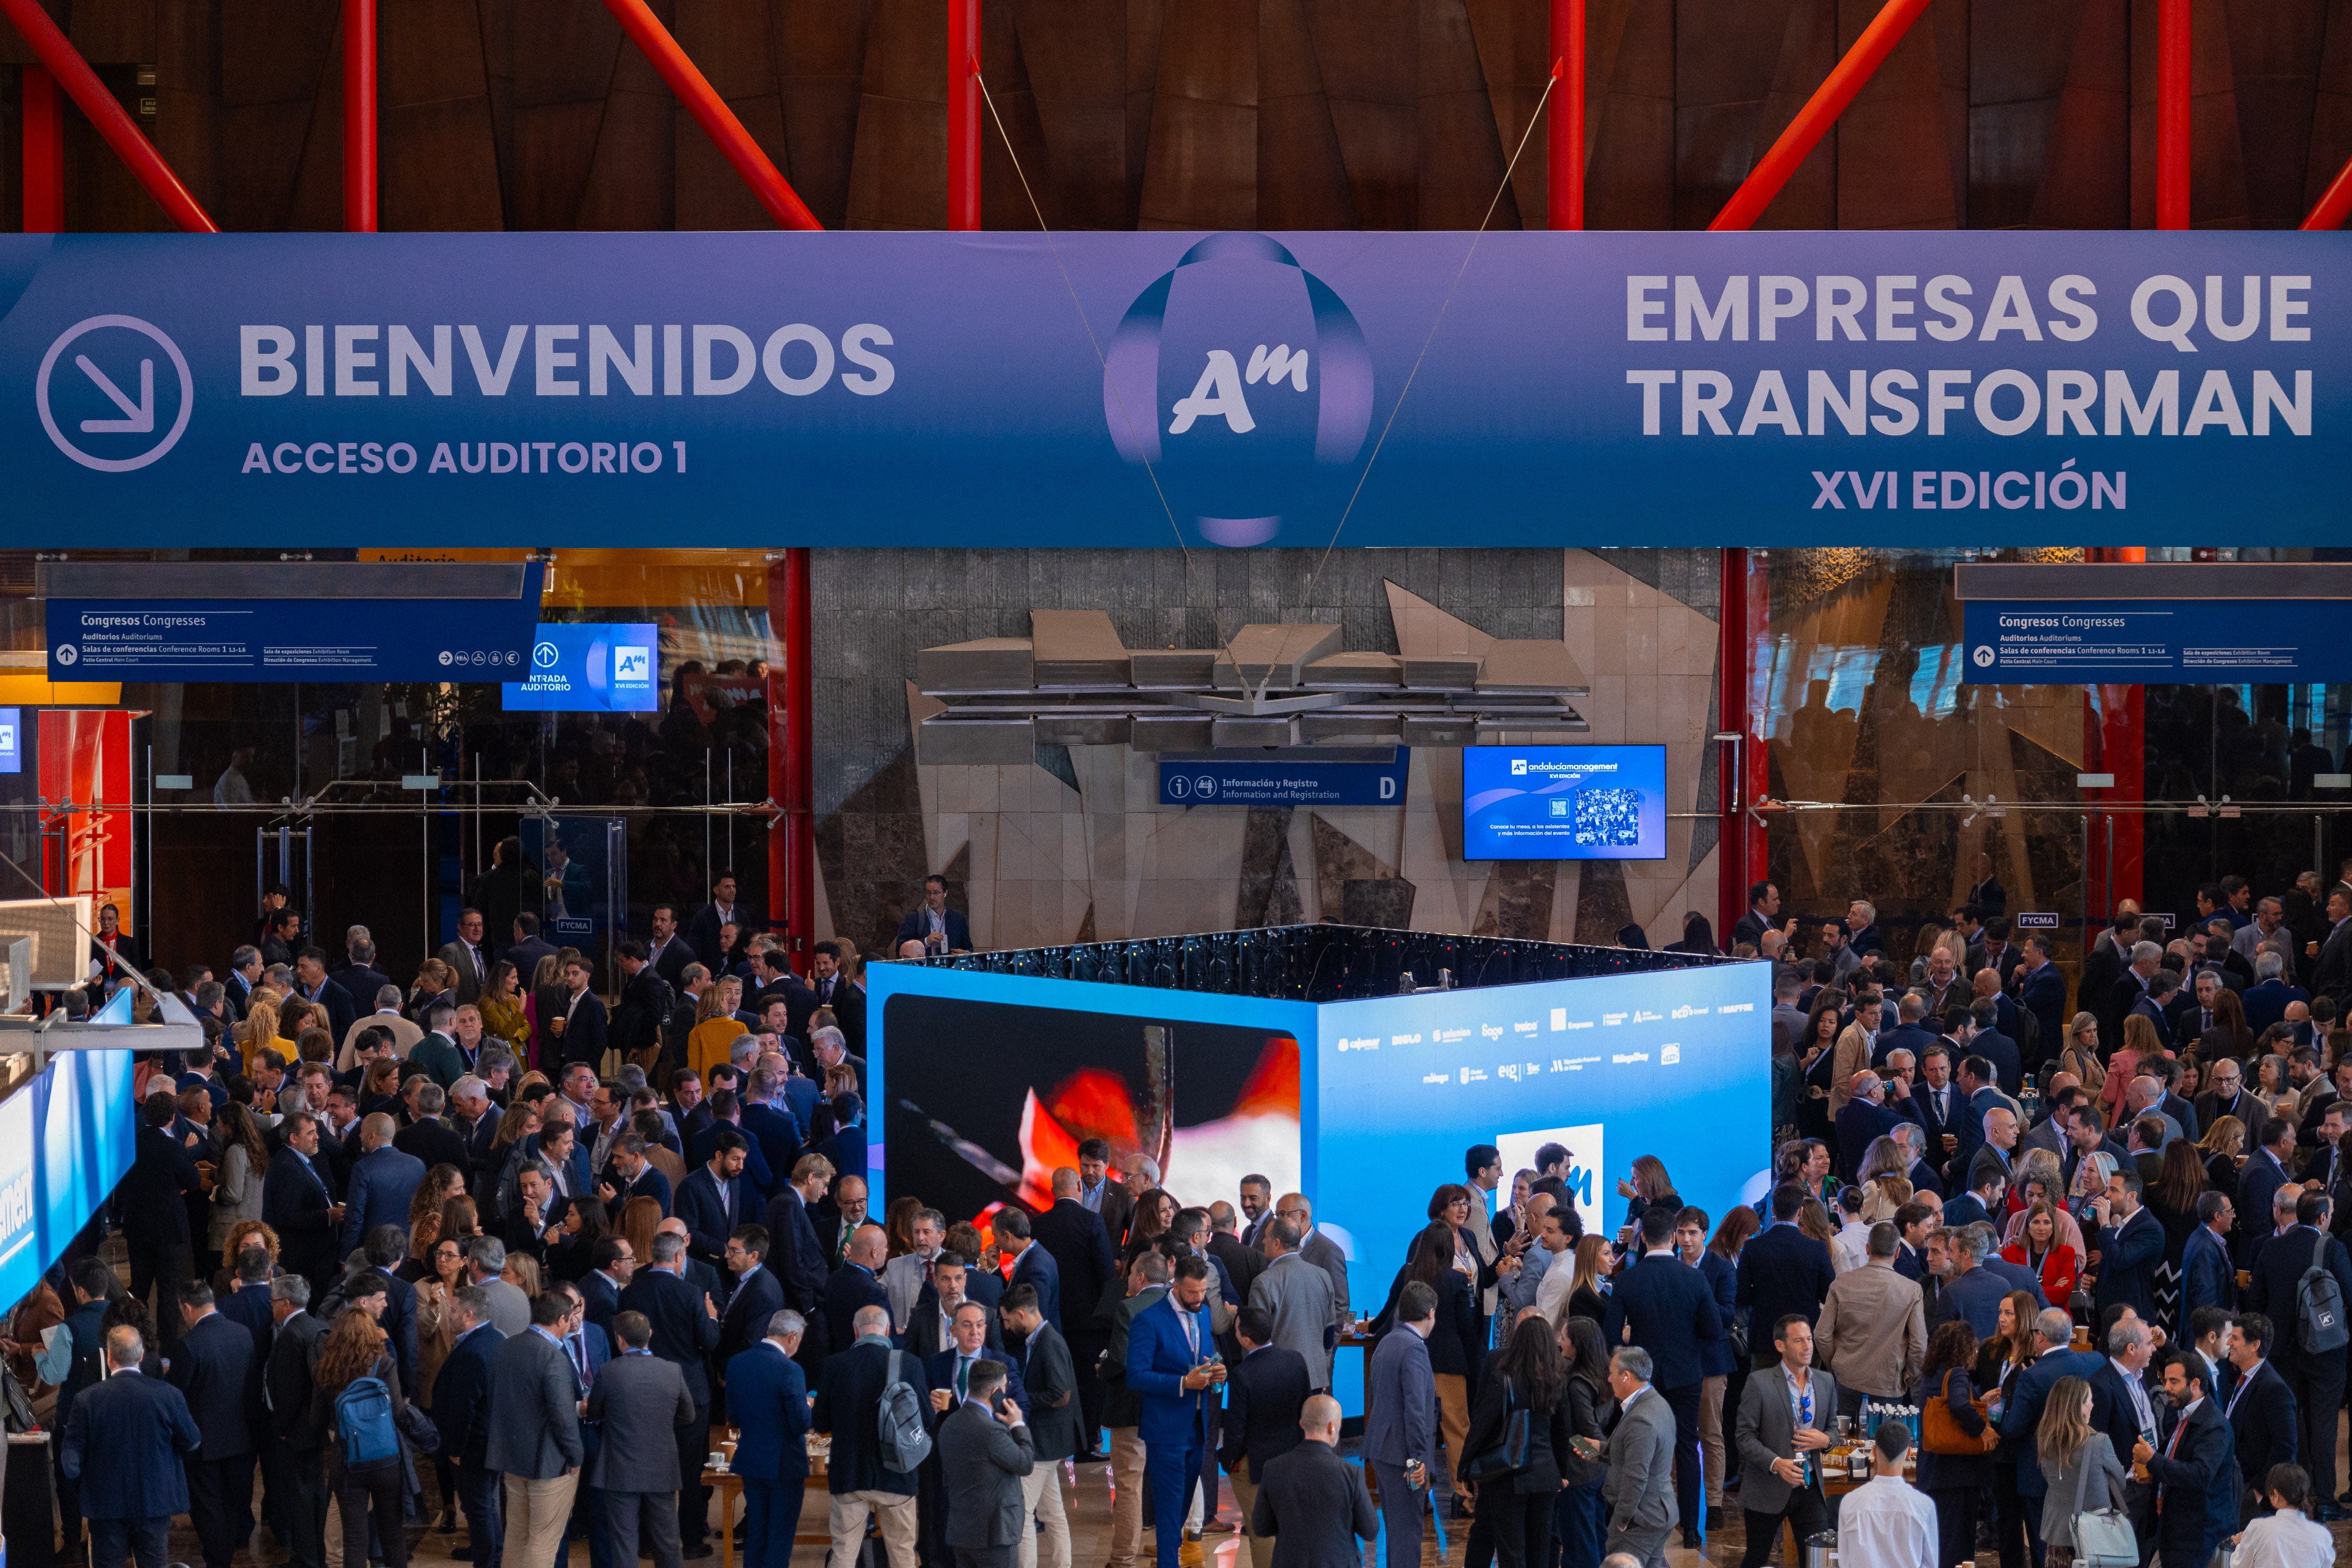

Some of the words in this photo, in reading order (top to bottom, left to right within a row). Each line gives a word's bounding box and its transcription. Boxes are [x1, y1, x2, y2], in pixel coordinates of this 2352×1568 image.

[1627, 275, 2097, 341] EMPRESAS
[2131, 275, 2311, 352] QUE
[240, 323, 894, 396] BIENVENIDOS
[1626, 369, 2312, 436] TRANSFORMAN
[242, 442, 417, 473] ACCESO
[428, 442, 662, 473] AUDITORIO
[673, 442, 686, 473] 1
[1812, 472, 1897, 509] XVI
[1913, 458, 2126, 509] EDICIÓN
[81, 615, 141, 628] Congresos
[143, 615, 206, 628] Congresses
[1999, 616, 2059, 629] Congresos
[2062, 616, 2125, 629] Congresses
[521, 683, 571, 691] AUDITORIO
[1528, 762, 1618, 772] andalucíamanagement
[1222, 779, 1274, 787] Información
[1283, 780, 1318, 788] Registro
[1380, 777, 1395, 799] D
[1222, 790, 1271, 798] Information
[1273, 790, 1288, 798] and
[1291, 790, 1339, 800] Registration
[560, 921, 588, 930] FYCMA
[1723, 1004, 1753, 1014] MAPFRE
[1442, 1028, 1471, 1038] solunion
[1482, 1024, 1503, 1041] Sage
[1423, 1072, 1448, 1084] málaga
